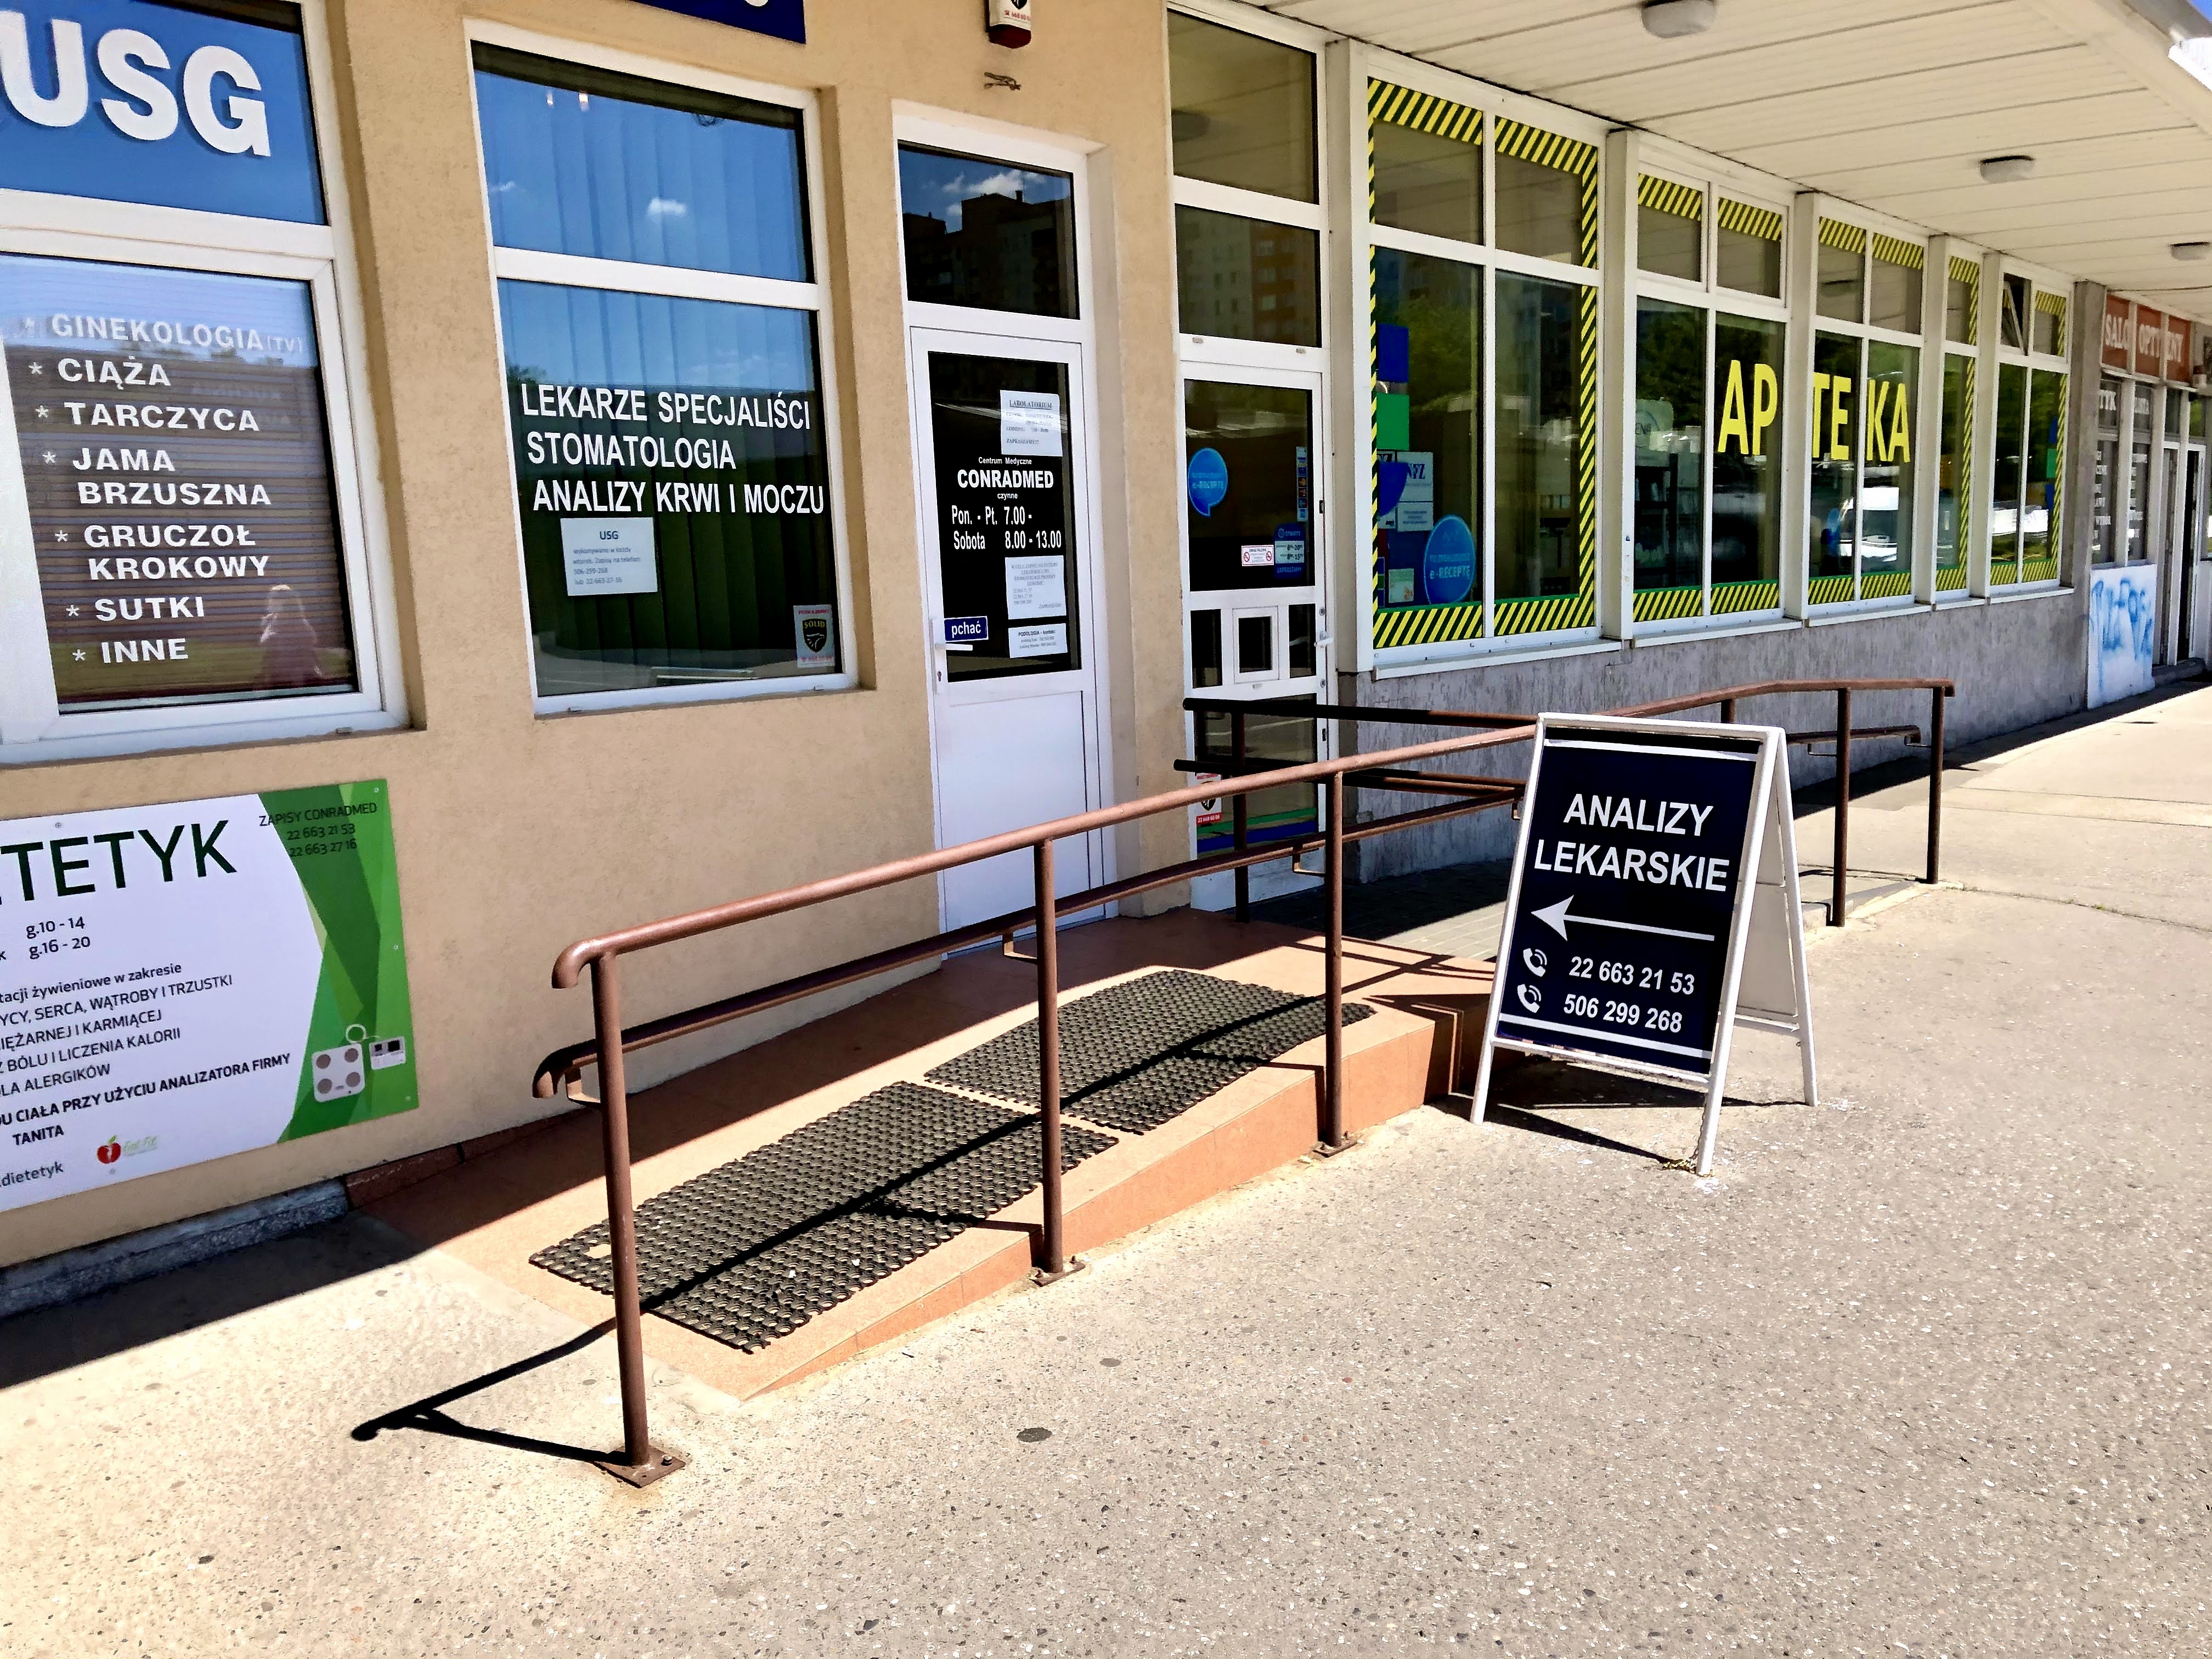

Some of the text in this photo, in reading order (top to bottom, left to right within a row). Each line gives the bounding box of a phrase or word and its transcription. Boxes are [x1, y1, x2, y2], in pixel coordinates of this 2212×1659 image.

[0, 10, 272, 157] USG
[52, 313, 263, 351] GINEKOLOGIA
[58, 356, 171, 390] CIĄŻA
[64, 401, 259, 432] TARCZYCA
[522, 383, 811, 430] LEKARZE SPECJALIŚCI
[72, 447, 175, 472] JAMA
[527, 431, 736, 470] STOMATOLOGIA
[978, 456, 1032, 467] Centrum Medyczne
[957, 469, 1054, 489] CONRADMED
[78, 482, 271, 505] BRZUSZNA
[533, 479, 824, 514] ANALIZY KRWI I MOCZU
[997, 493, 1018, 501] czynne
[951, 505, 973, 526] Pon.
[985, 505, 997, 525] Pt.
[1004, 506, 1025, 524] 7.00
[84, 523, 256, 548] GRUCZOŁ
[600, 531, 619, 540] USG
[953, 530, 986, 550] Sobota
[1005, 530, 1026, 549] 8.00
[1036, 530, 1062, 549] 13.00
[88, 556, 270, 580] KROKOWY
[94, 596, 205, 621] SUTKI
[804, 620, 825, 629] SOLID
[952, 620, 981, 638] pchać
[101, 638, 189, 664] INNE
[259, 802, 377, 827] ZAPISY CONRADMED
[1563, 793, 1713, 837] ANALIZY
[286, 823, 356, 840] 22 663 21 53
[290, 838, 357, 857] 22 663 27 16
[0, 820, 237, 905] TETYK
[1534, 839, 1730, 892] LEKARSKIE
[26, 921, 55, 940] g.10
[70, 916, 85, 930] 14
[29, 939, 59, 960] g.16
[72, 936, 91, 950] 20
[32, 976, 111, 1000] żywieniowe
[114, 973, 125, 983] w
[128, 963, 182, 981] zakresie
[1569, 956, 1695, 996] 22 663 21 53
[35, 1001, 87, 1020] SERCA,
[89, 988, 158, 1011] WĄTROBY
[162, 986, 166, 997] I
[169, 974, 232, 996] TRZUSTKI
[83, 1009, 162, 1034] KARMIĄCEJ
[1563, 994, 1683, 1034] 506 299 268
[7, 1053, 48, 1072] BÓLU
[59, 1039, 124, 1062] LICZENIA
[127, 1027, 181, 1048] KALORII
[16, 1103, 59, 1122] CIAŁA
[62, 1094, 100, 1113] PRZY
[104, 1081, 156, 1104] UŻYCIU
[159, 1061, 251, 1092] ANALIZATORA
[252, 1053, 291, 1071] FIRMY
[24, 1063, 110, 1092] ALERGIKÓW
[12, 1125, 65, 1146] TANITA
